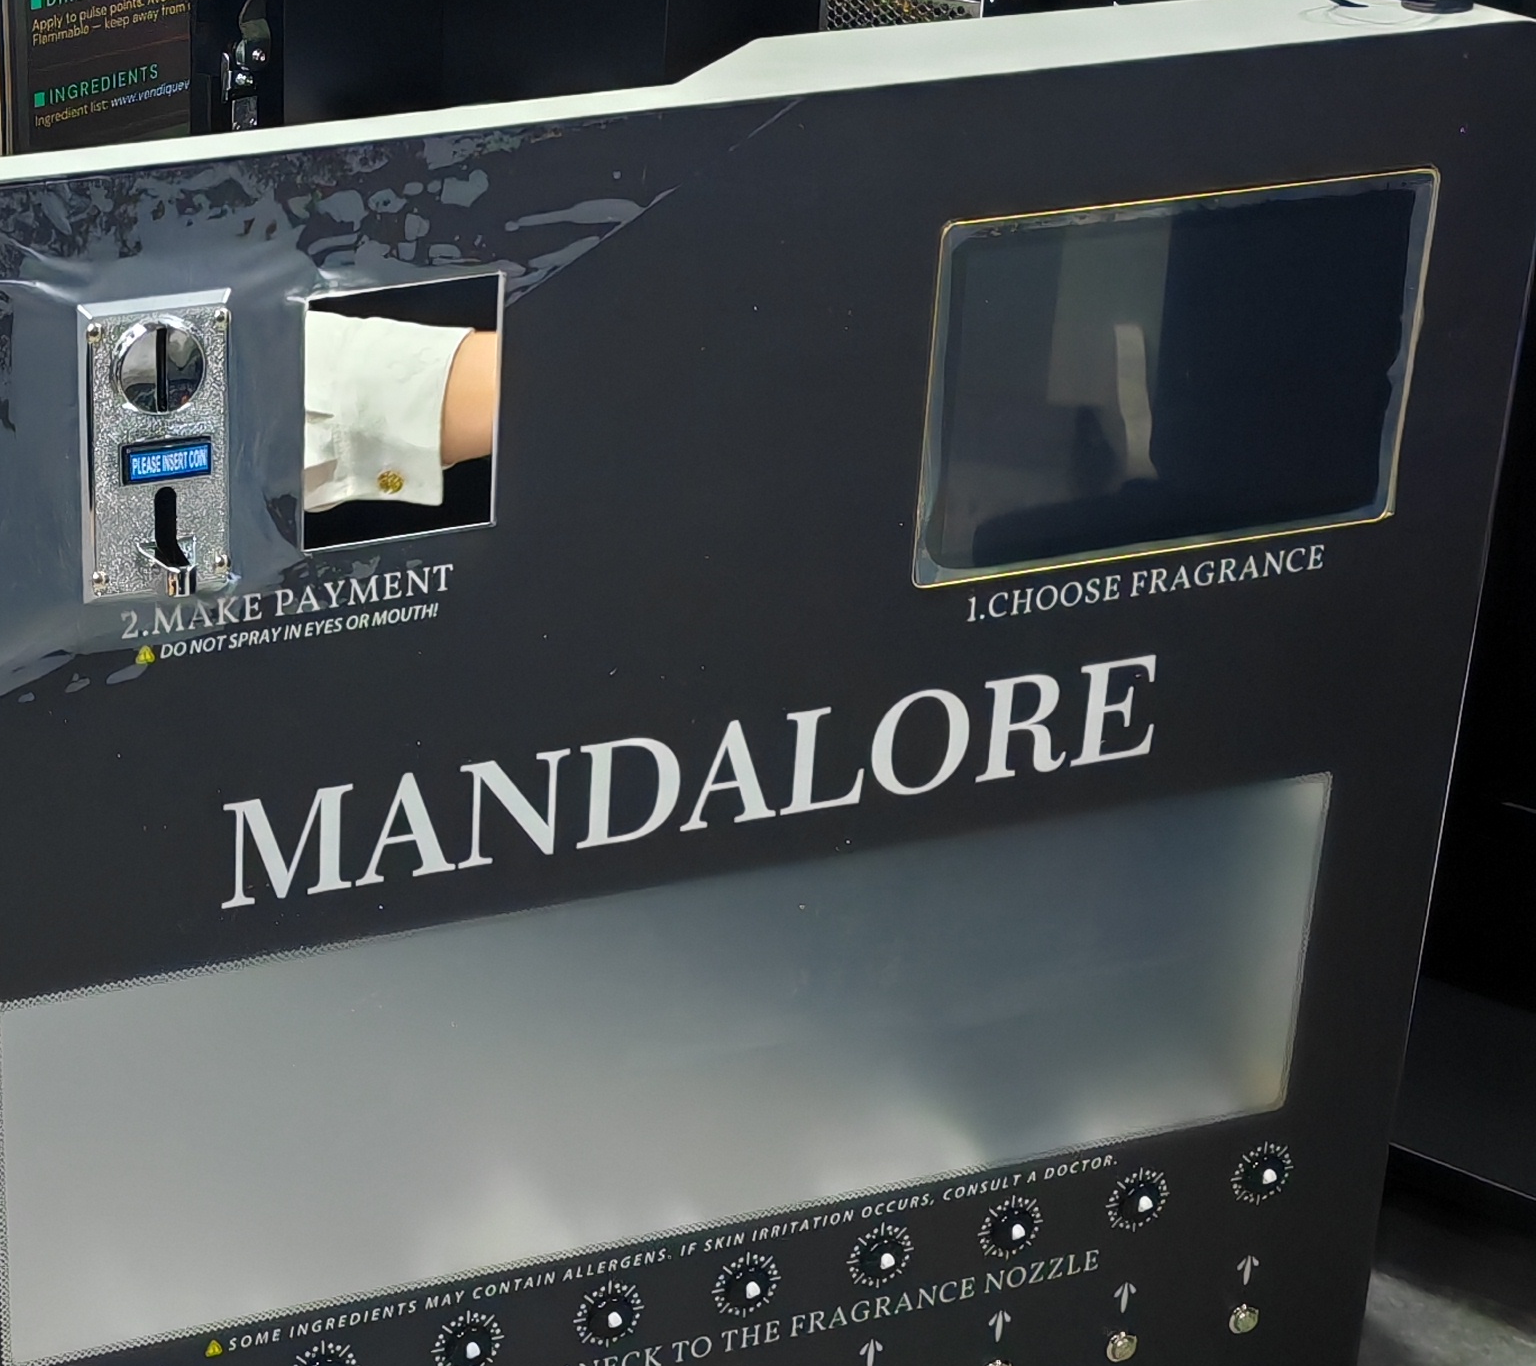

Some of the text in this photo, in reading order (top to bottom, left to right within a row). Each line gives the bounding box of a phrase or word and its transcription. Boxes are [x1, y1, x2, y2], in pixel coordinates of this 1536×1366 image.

[31, 15, 63, 33] Apply
[65, 11, 77, 23] to
[78, 5, 107, 24] pulse
[32, 25, 90, 47] Flammable
[104, 15, 130, 30] keep
[132, 9, 159, 23] away
[161, 2, 185, 16] from
[49, 63, 159, 105] INGREDIENTS
[34, 104, 88, 129] Ingredient
[131, 454, 161, 476] PLEASE
[162, 451, 188, 472] INSERT
[120, 563, 455, 640] 2.MAKE PAYMENT
[966, 543, 1326, 623] 1.CHOOSE FRAGRANCE
[160, 602, 440, 660] DO NOT SPRAY IN EYES OR MOUTH!
[220, 653, 1159, 910] MANDALORE
[227, 1327, 282, 1353] SOME
[289, 1299, 418, 1339] INGREDIENTS
[424, 1289, 466, 1311] MAY
[472, 1271, 556, 1301] CONTAIN
[679, 1240, 697, 1257] IF
[703, 1231, 745, 1252] SKIN
[751, 1209, 855, 1243] IRRITATION
[861, 1195, 936, 1219] OCCURS,
[942, 1173, 1022, 1202] CONSULT
[1026, 1171, 1038, 1184] A
[1044, 1154, 1119, 1179] DOCTOR.
[672, 1335, 713, 1364] TO
[721, 1320, 781, 1354] THE
[789, 1276, 976, 1337] FRAGRANCE
[983, 1249, 1101, 1295] NOZZLE
